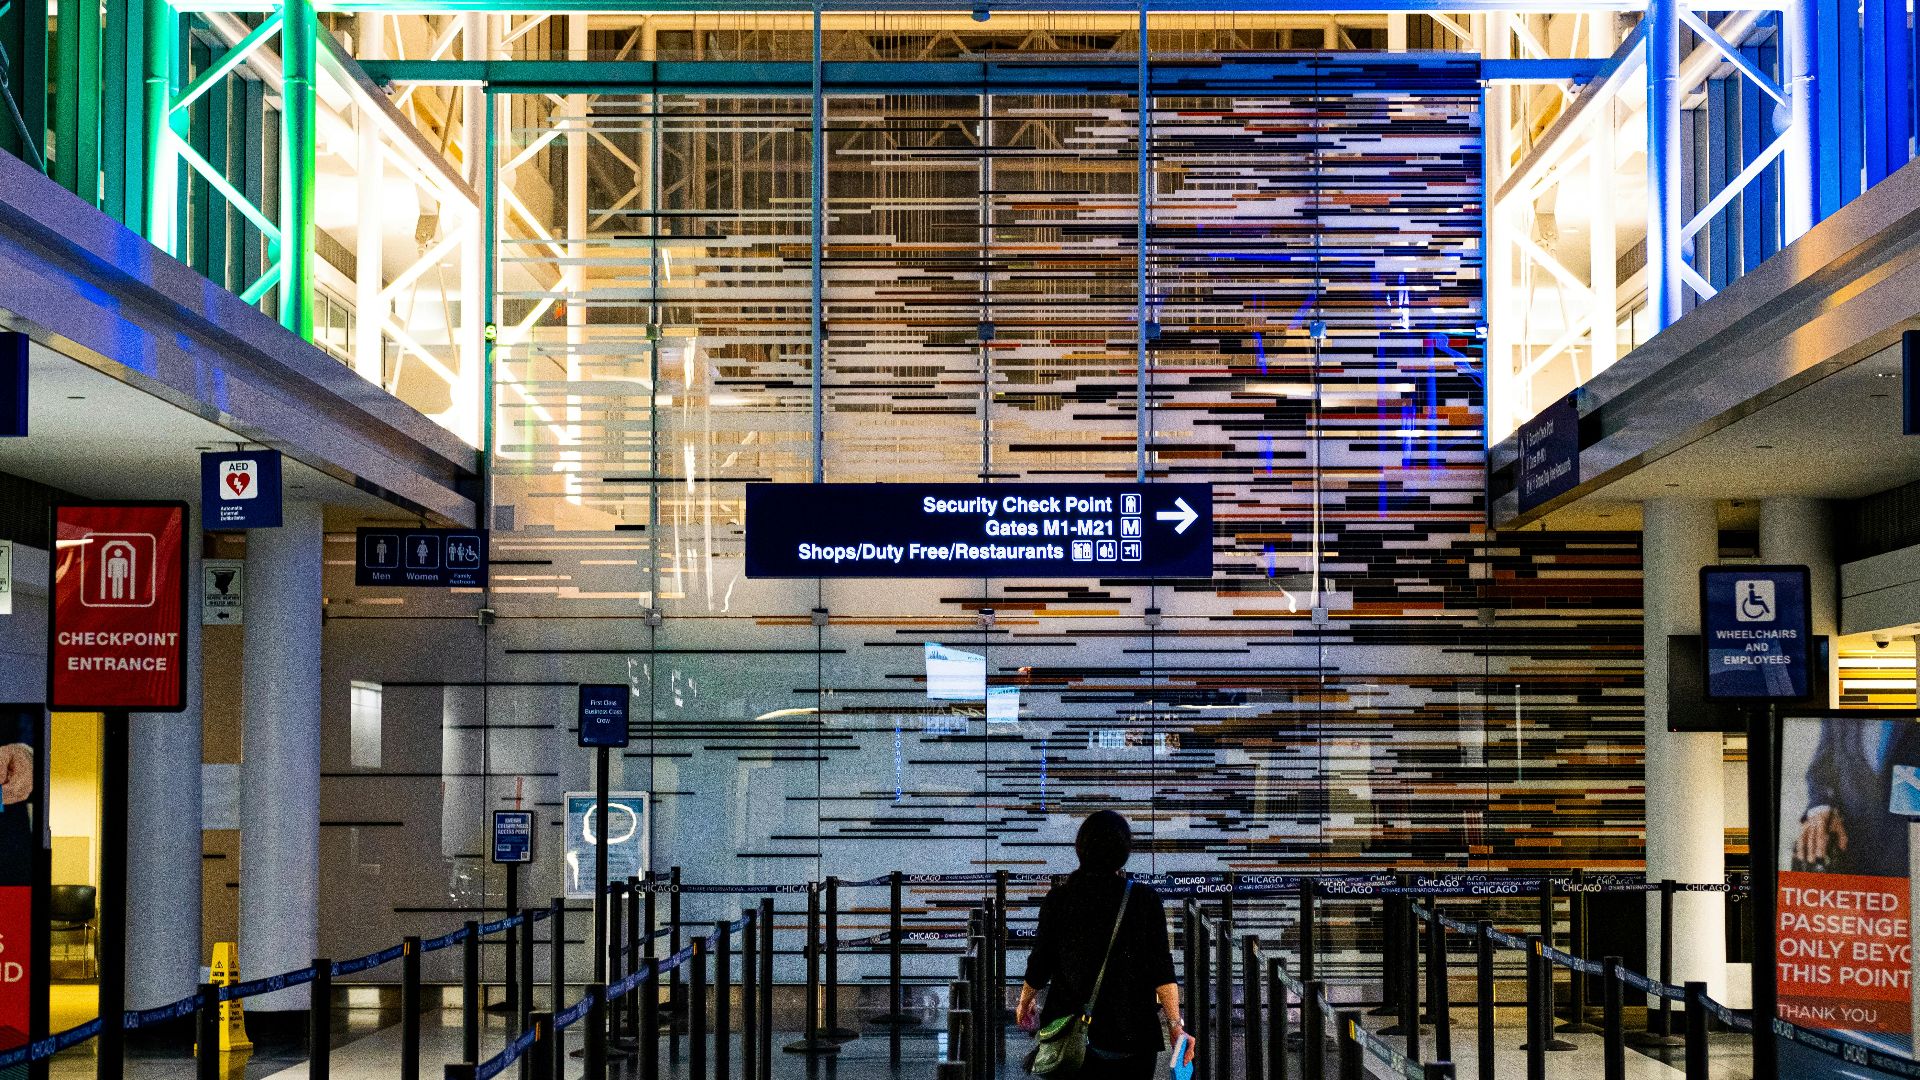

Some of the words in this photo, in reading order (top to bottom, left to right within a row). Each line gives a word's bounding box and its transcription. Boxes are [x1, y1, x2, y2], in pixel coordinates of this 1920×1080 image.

[229, 463, 248, 471] AED
[924, 497, 997, 515] Security
[1003, 497, 1060, 513] Check
[1066, 497, 1112, 513] Point
[986, 520, 1038, 536] Gates
[1044, 520, 1112, 536] M1-M21
[1123, 520, 1139, 535] M
[799, 543, 904, 562] Shops/Duty
[910, 543, 1063, 560] Free/Restaurants
[372, 572, 391, 580] Men
[407, 572, 438, 581] Women
[58, 632, 177, 646] CHECKPOINT
[1716, 629, 1796, 639] WHEELCHAIRS
[1746, 642, 1769, 652] AND
[68, 657, 167, 671] ENTRANCE
[1723, 655, 1791, 665] EMPLOYEES
[909, 874, 941, 882] CHICAGO
[1174, 877, 1206, 885] CHICAGO
[1241, 876, 1283, 884] CHICAGO
[1417, 879, 1460, 887] CHICAGO
[634, 884, 679, 893] CHICAGO
[1196, 884, 1233, 893] CHICAGO
[1327, 886, 1373, 894] CHICAGO
[1471, 885, 1518, 894] CHICAGO
[1562, 884, 1602, 892] CHICAGO
[1685, 884, 1731, 892] CHICAGO
[1781, 887, 1899, 911] TICKETED
[1780, 912, 1909, 938] PASSENGE
[909, 932, 940, 940] CHICAGO
[1016, 929, 1037, 938] CHIC
[1779, 938, 1844, 959] ONLY
[0, 962, 23, 982] D
[1778, 963, 1832, 984] THIS
[1840, 966, 1911, 988] POINT
[1777, 1004, 1836, 1021] THANK
[1841, 1006, 1877, 1023] YOU
[31, 1036, 56, 1061] CHICAGO
